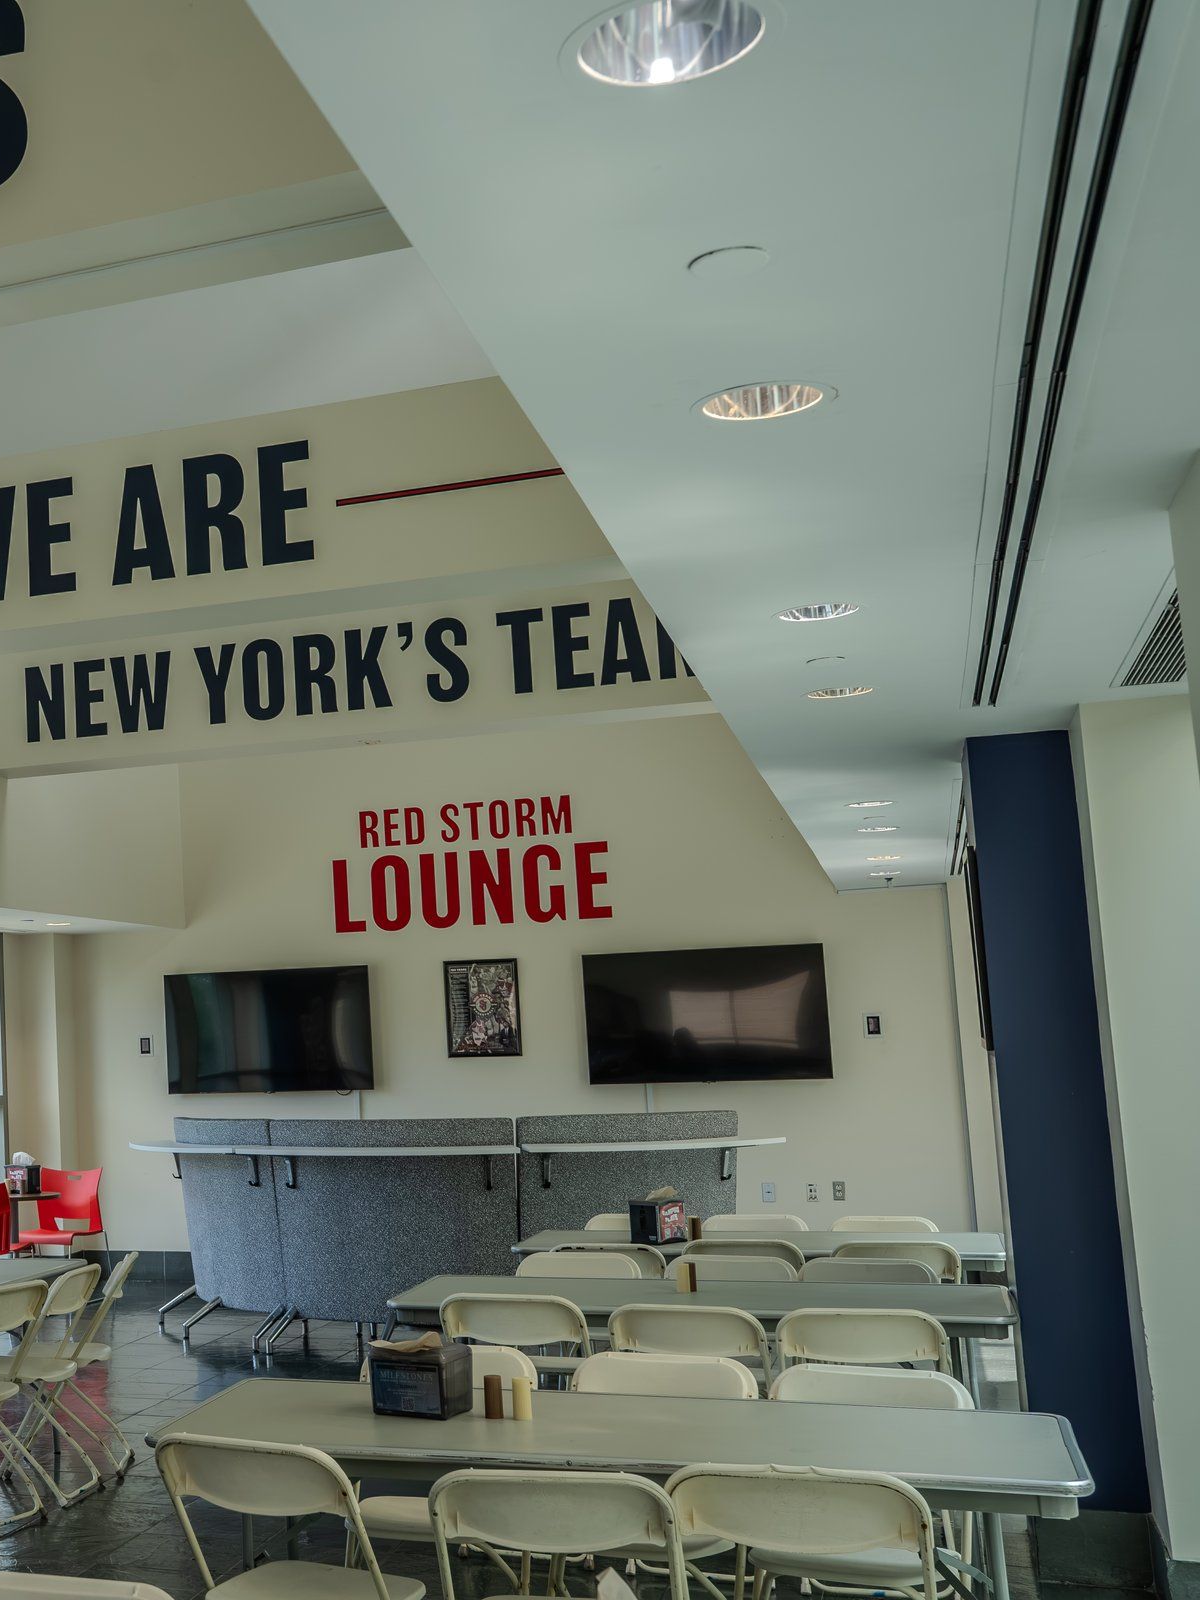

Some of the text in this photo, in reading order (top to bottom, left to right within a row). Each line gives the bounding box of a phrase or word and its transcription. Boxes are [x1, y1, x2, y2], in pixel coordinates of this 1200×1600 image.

[111, 439, 315, 587] ARE
[24, 650, 171, 744] NEW
[193, 617, 470, 725] YORK'S
[359, 794, 573, 849] RED STORM
[332, 840, 613, 934] LOUNGE
